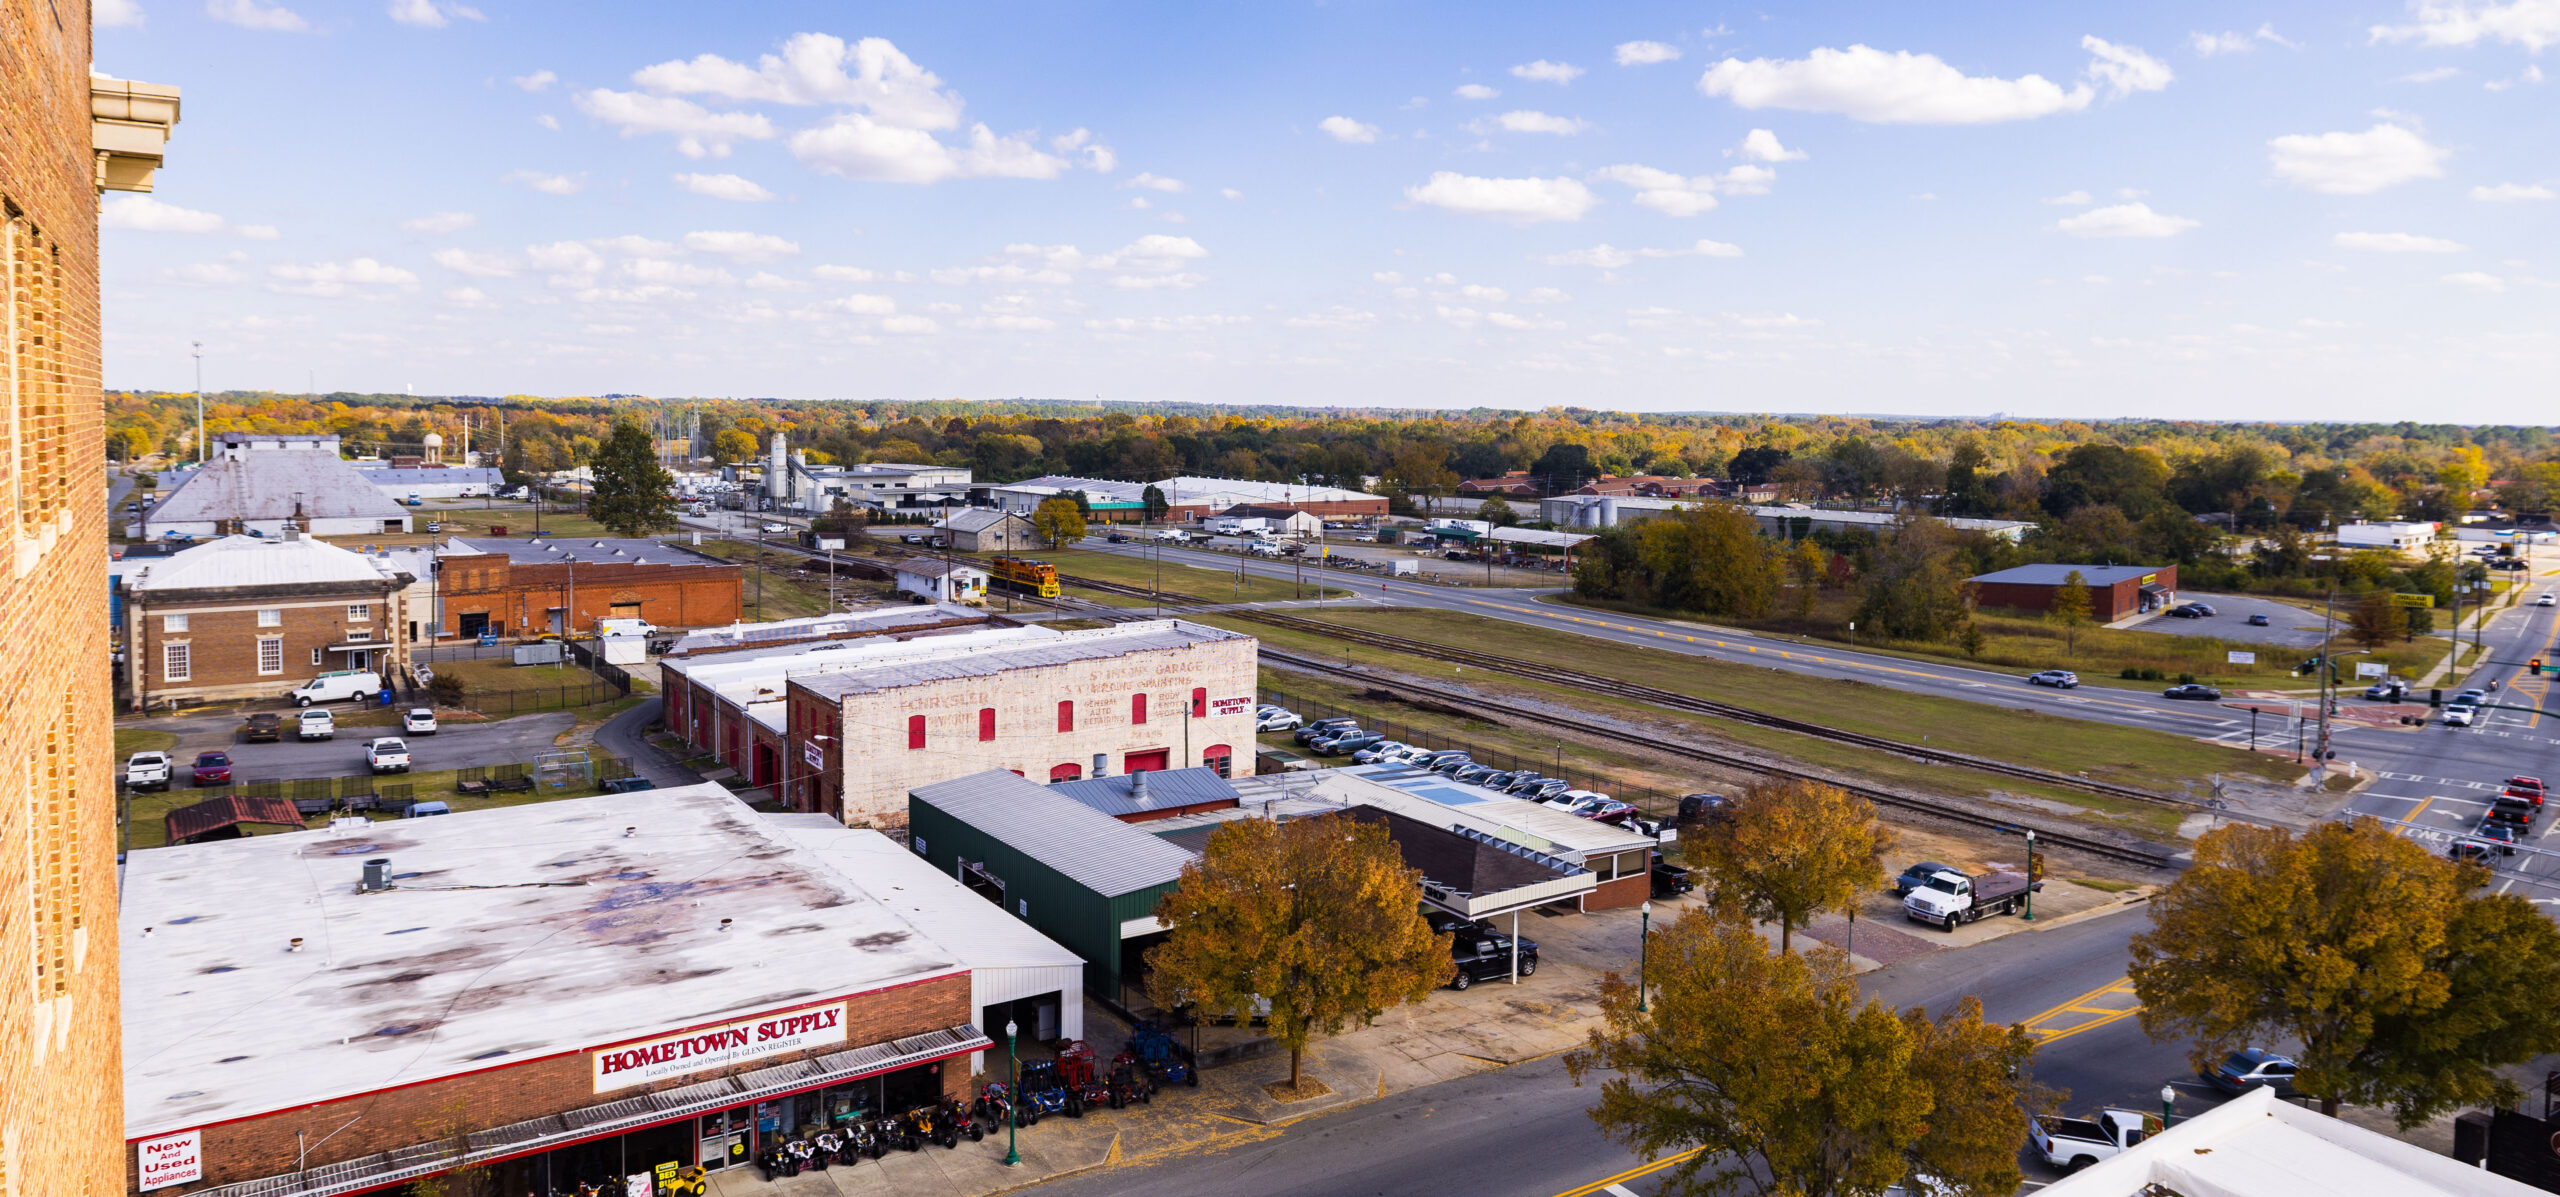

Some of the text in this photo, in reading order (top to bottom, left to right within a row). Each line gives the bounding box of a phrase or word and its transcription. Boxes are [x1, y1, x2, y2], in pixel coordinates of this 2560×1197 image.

[1155, 661, 1203, 675] GARAGE
[1159, 692, 1180, 701] BODY
[1212, 697, 1251, 707] HOMETOWN
[1090, 708, 1111, 716] AUTO
[1220, 706, 1245, 715] SUPPLY
[1425, 886, 1447, 901] SHOP
[601, 1008, 840, 1075] HOMETOWN SUPPLY
[645, 1038, 802, 1078] Locally Owned and Operated By GLENN REGISTER
[147, 1139, 192, 1154] New
[160, 1150, 181, 1160] And
[145, 1156, 195, 1173] Used
[144, 1168, 197, 1186] Appliances
[659, 1170, 676, 1180] BED
